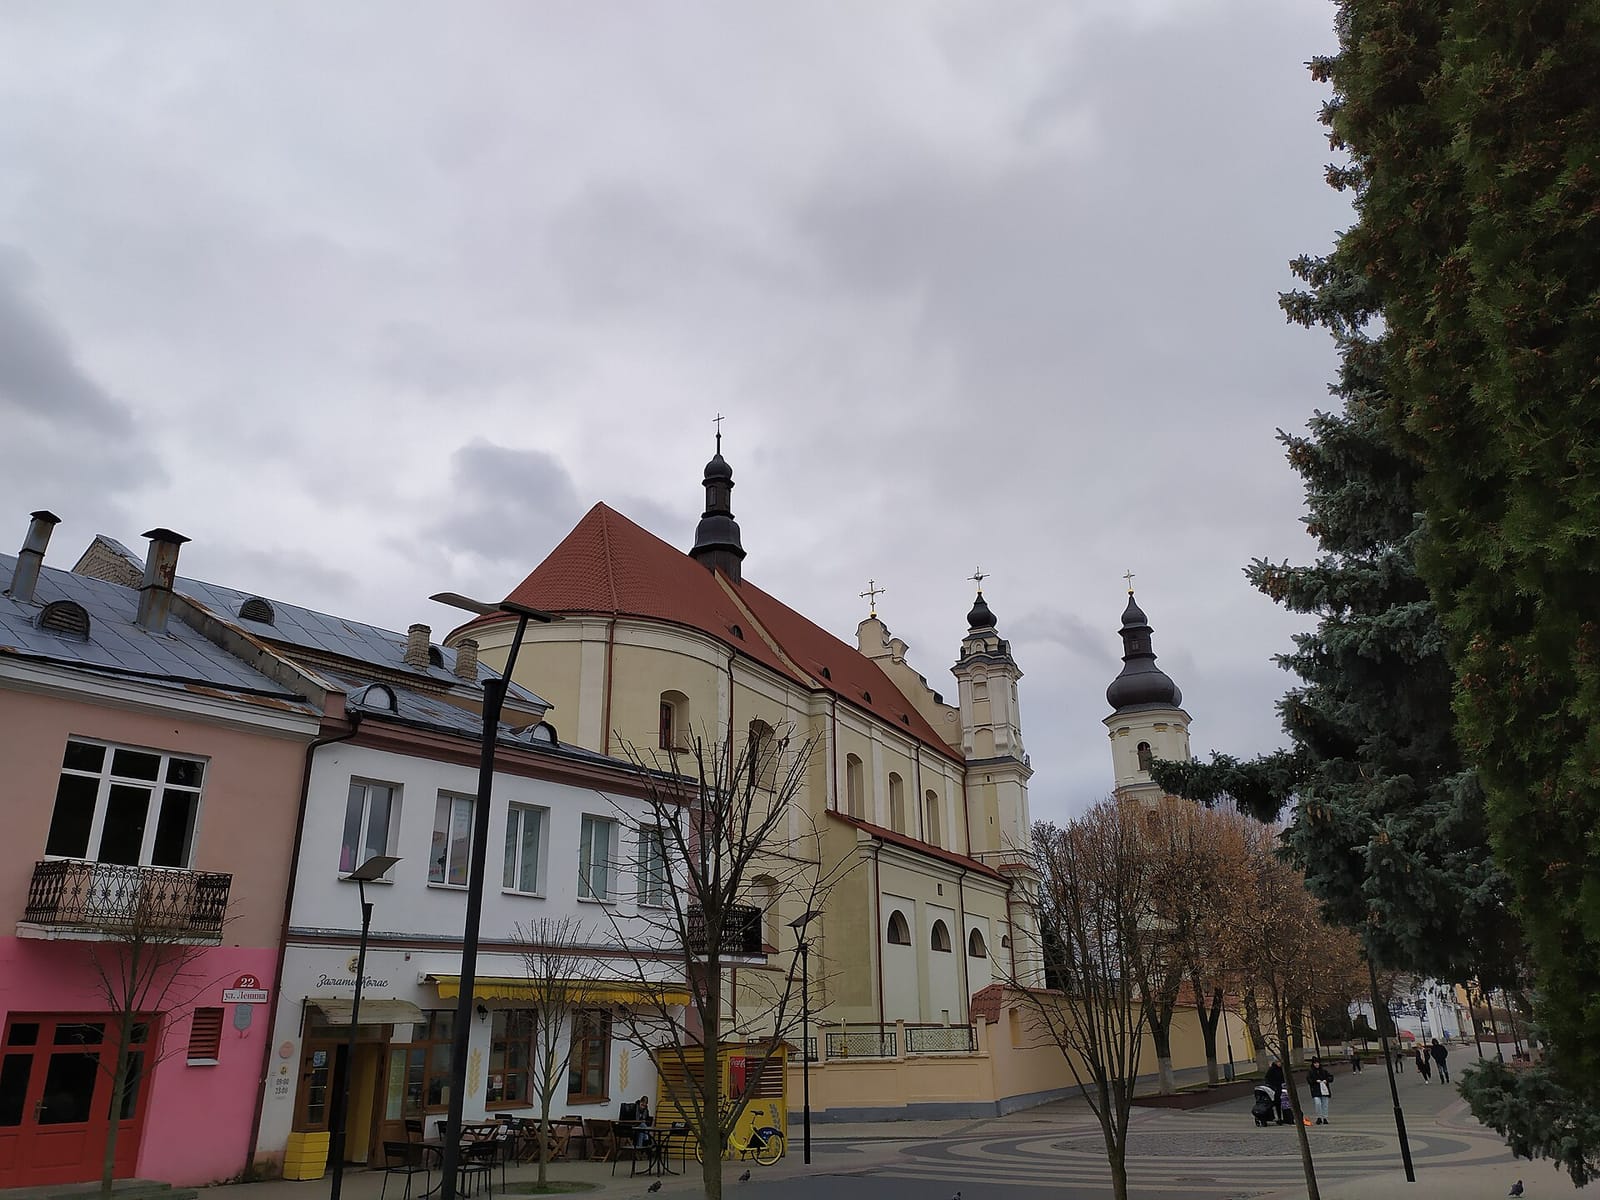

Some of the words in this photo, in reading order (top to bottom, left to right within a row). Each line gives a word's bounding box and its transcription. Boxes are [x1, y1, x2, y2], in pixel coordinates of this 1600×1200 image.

[240, 977, 255, 988] 22
[224, 992, 236, 1001] ул.
[237, 991, 266, 1000] Ленина
